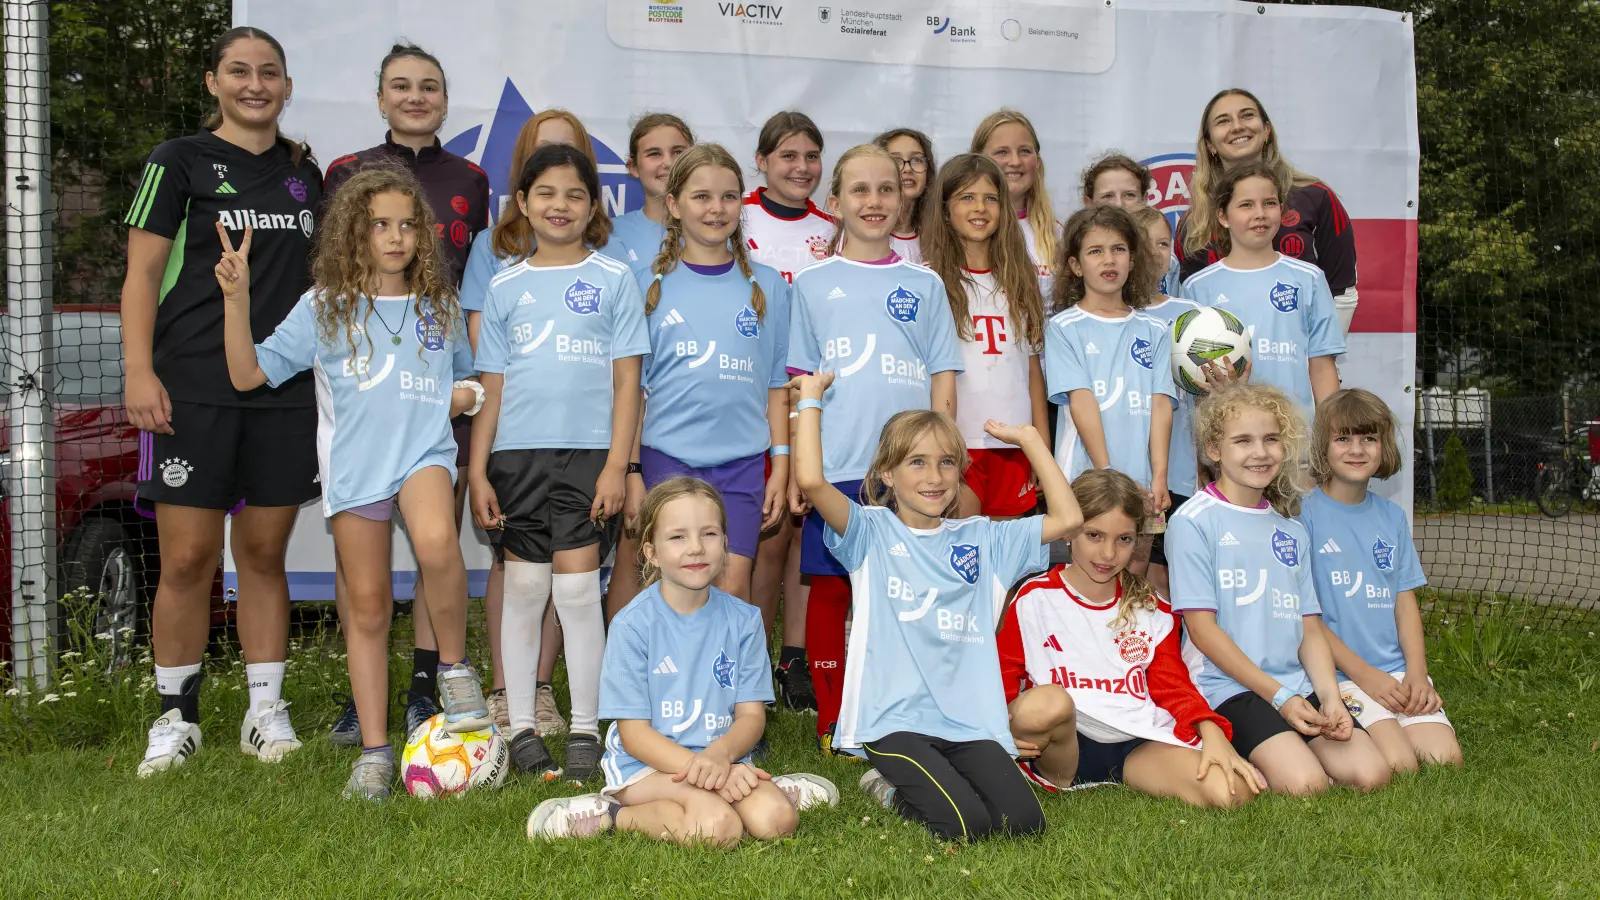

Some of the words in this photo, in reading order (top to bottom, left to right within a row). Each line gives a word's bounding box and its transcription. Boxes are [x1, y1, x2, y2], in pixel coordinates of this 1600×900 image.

[648, 10, 683, 18] POSTCODE
[718, 2, 783, 19] VIACTIV
[841, 8, 902, 22] Landeshauptstadt
[840, 17, 874, 27] München
[926, 16, 940, 26] BB
[840, 26, 887, 37] Sozialreferat
[950, 26, 976, 36] Bank
[1056, 30, 1078, 40] Stiftung
[218, 209, 297, 231] Allianz
[556, 334, 604, 356] Bank
[676, 340, 698, 356] BB
[826, 336, 852, 360] BB
[1258, 338, 1297, 354] Bank
[558, 354, 582, 364] Better
[720, 354, 754, 372] Bank
[880, 353, 926, 381] Bank
[1218, 569, 1247, 588] BB
[1331, 570, 1351, 585] BB
[888, 576, 914, 602] BB
[1365, 584, 1390, 598] Ban
[1272, 588, 1300, 610] Ban
[1272, 610, 1291, 620] Better
[814, 660, 837, 669] FCB
[661, 700, 684, 718] BB
[705, 713, 732, 730] Ban
